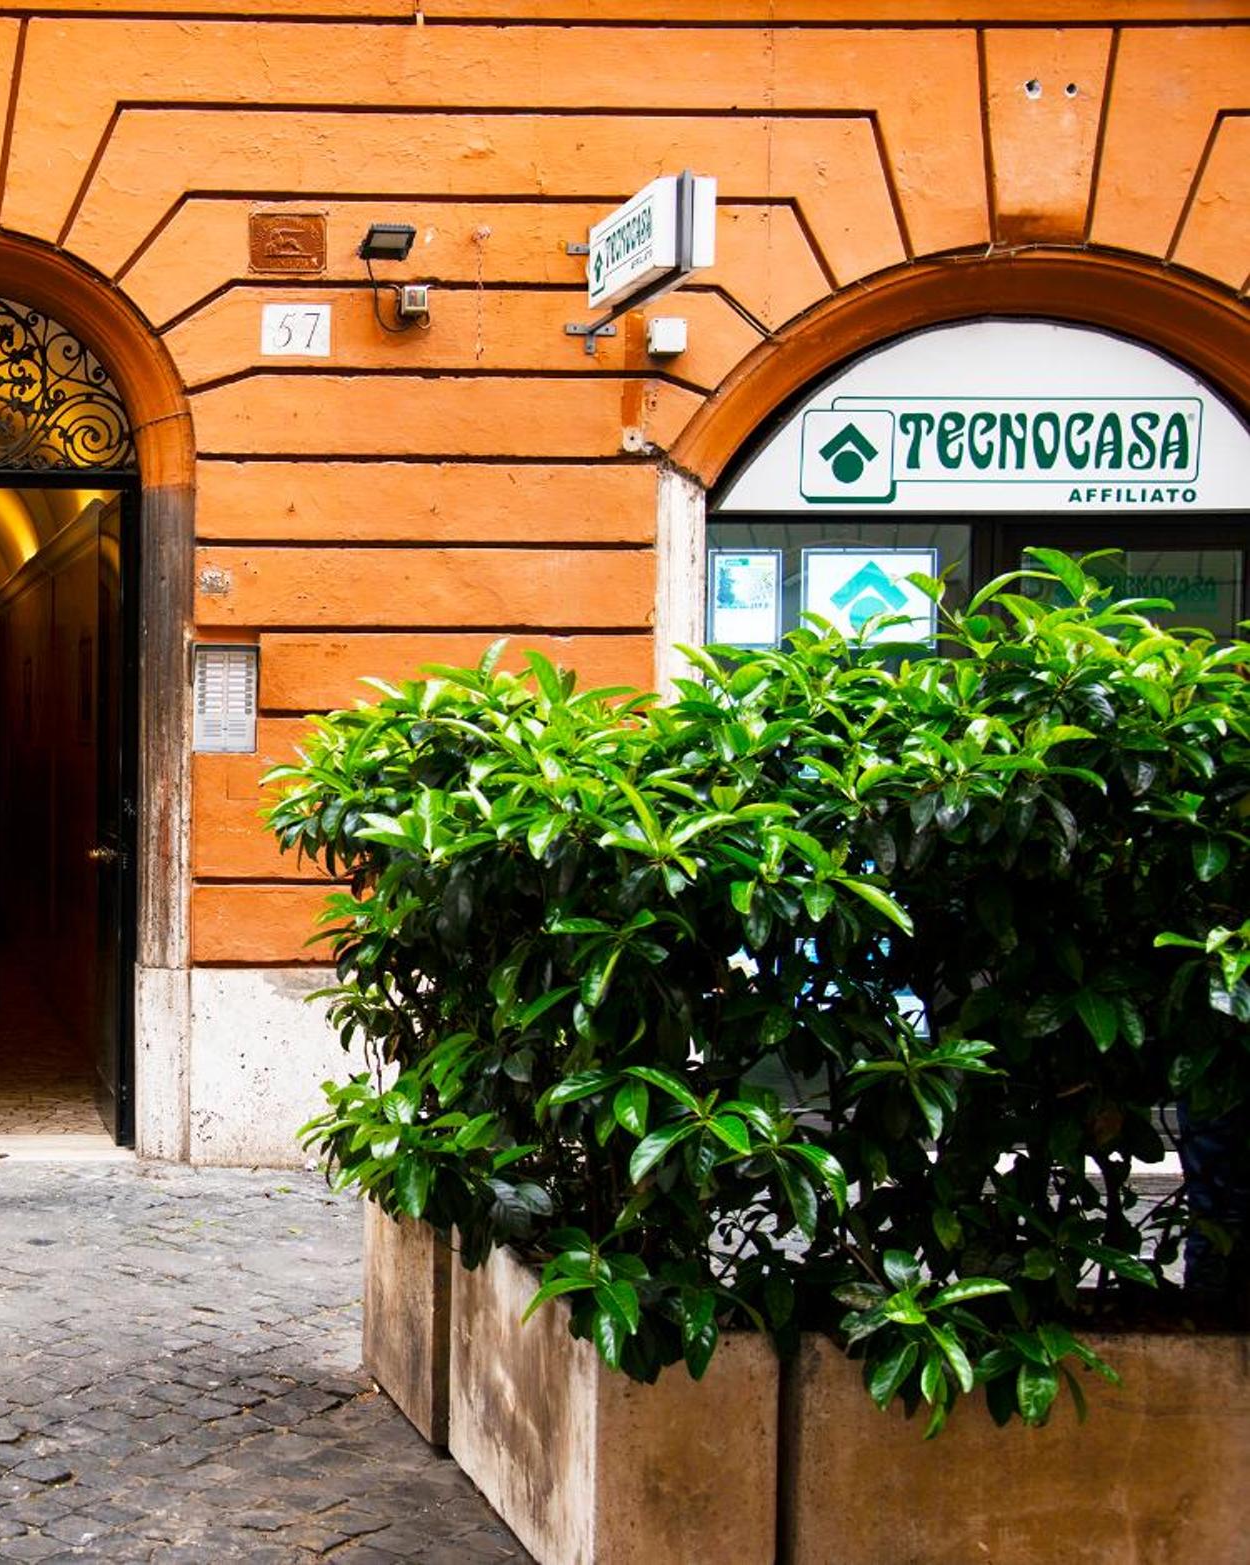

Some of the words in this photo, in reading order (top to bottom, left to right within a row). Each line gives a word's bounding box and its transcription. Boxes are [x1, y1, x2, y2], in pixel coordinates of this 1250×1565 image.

[275, 312, 321, 348] 57
[900, 412, 1188, 469] TECNOCASA
[1069, 489, 1196, 503] AFFILIATO
